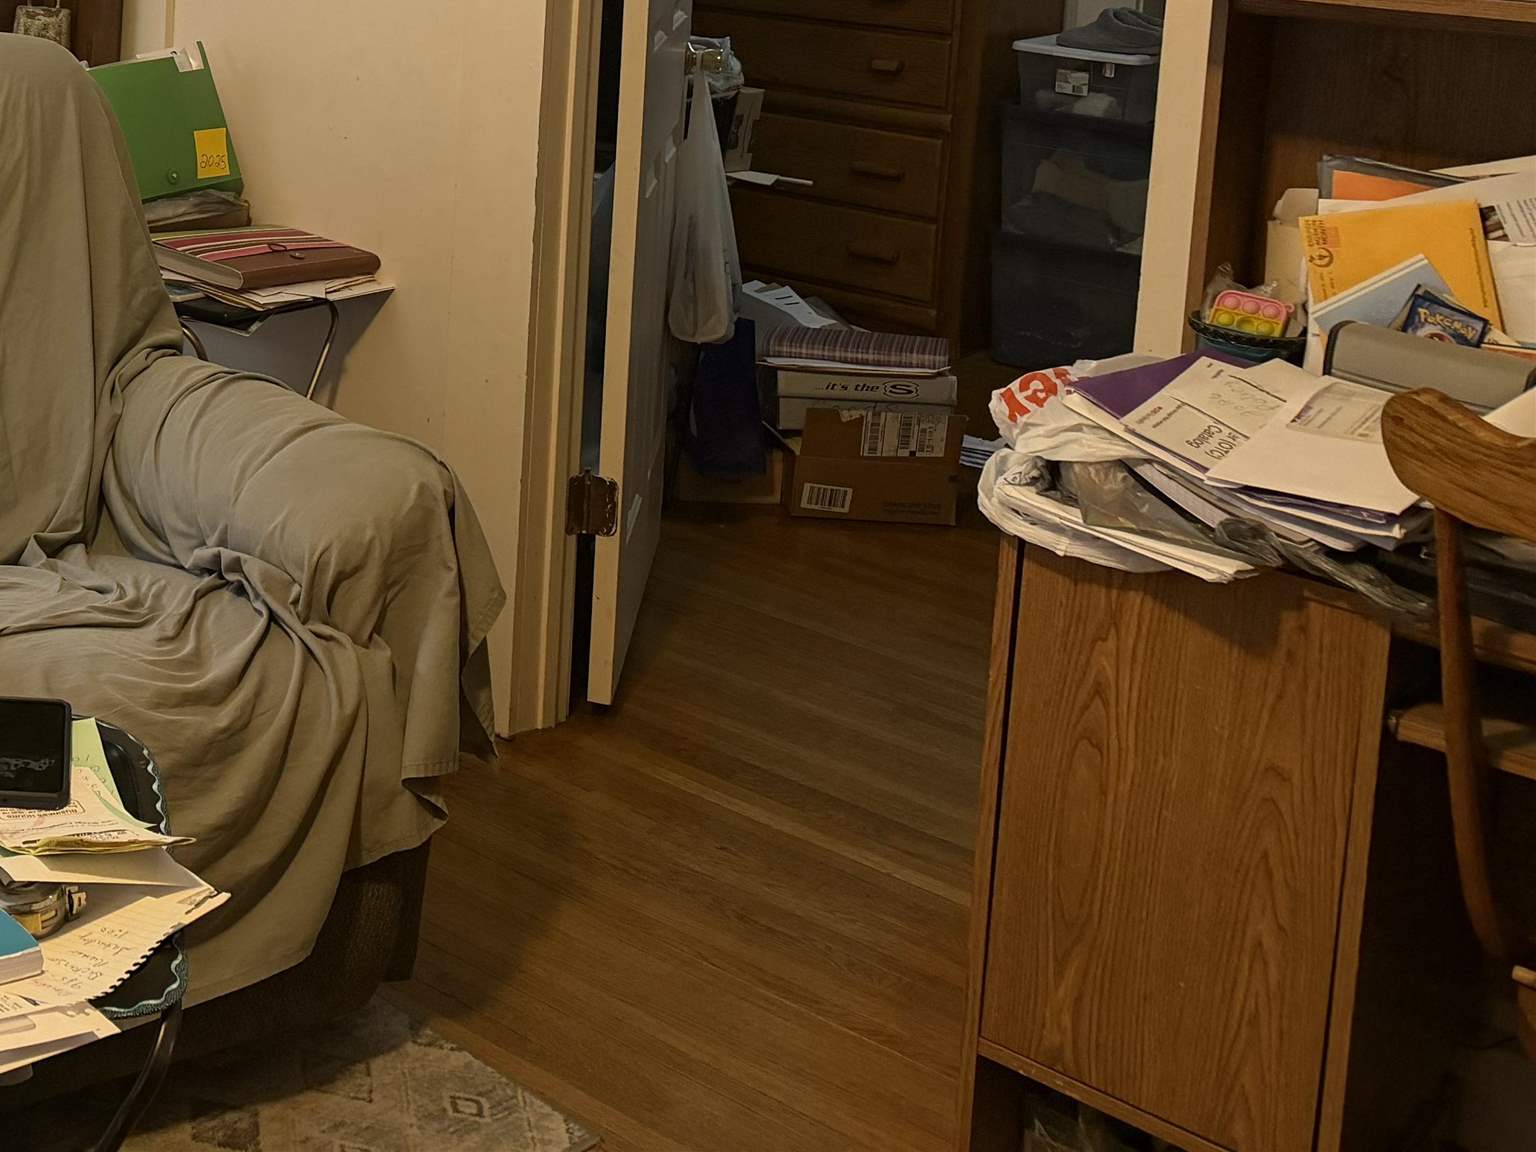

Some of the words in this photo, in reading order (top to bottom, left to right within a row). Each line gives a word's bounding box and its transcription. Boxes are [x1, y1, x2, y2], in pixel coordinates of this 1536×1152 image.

[854, 383, 880, 392] the
[1185, 424, 1223, 448] Catalog
[1205, 438, 1237, 460] (OTC)
